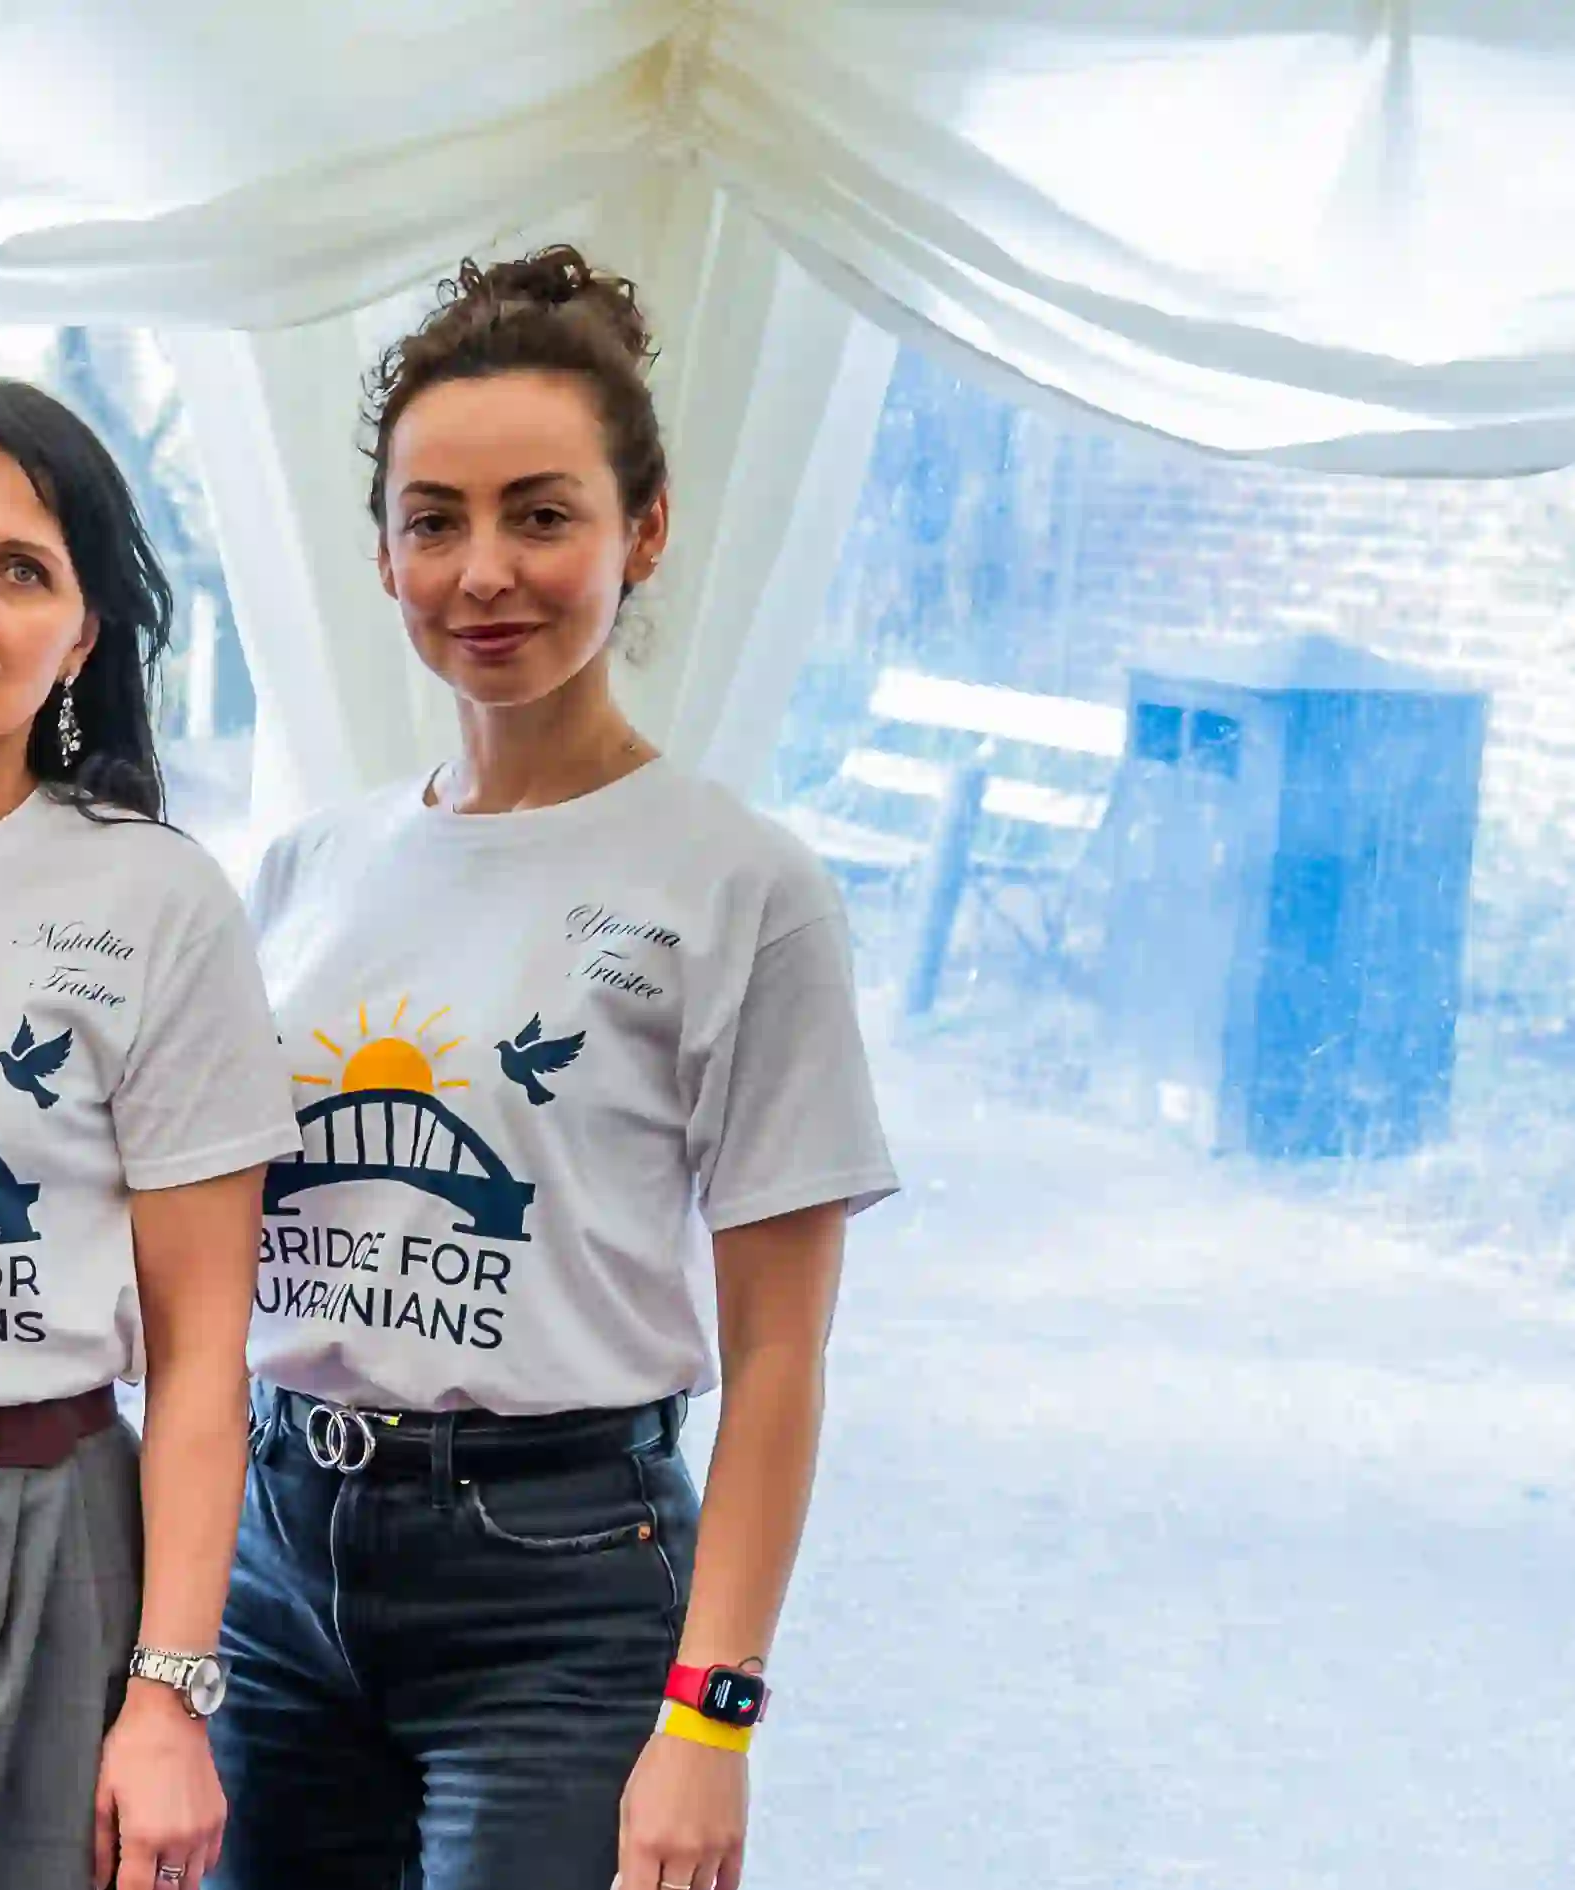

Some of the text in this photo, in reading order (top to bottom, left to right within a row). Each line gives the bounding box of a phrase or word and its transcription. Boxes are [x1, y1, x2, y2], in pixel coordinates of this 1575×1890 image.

[30, 966, 126, 1008] Trustee
[566, 949, 663, 1000] Trustee
[400, 1235, 511, 1295] FOR
